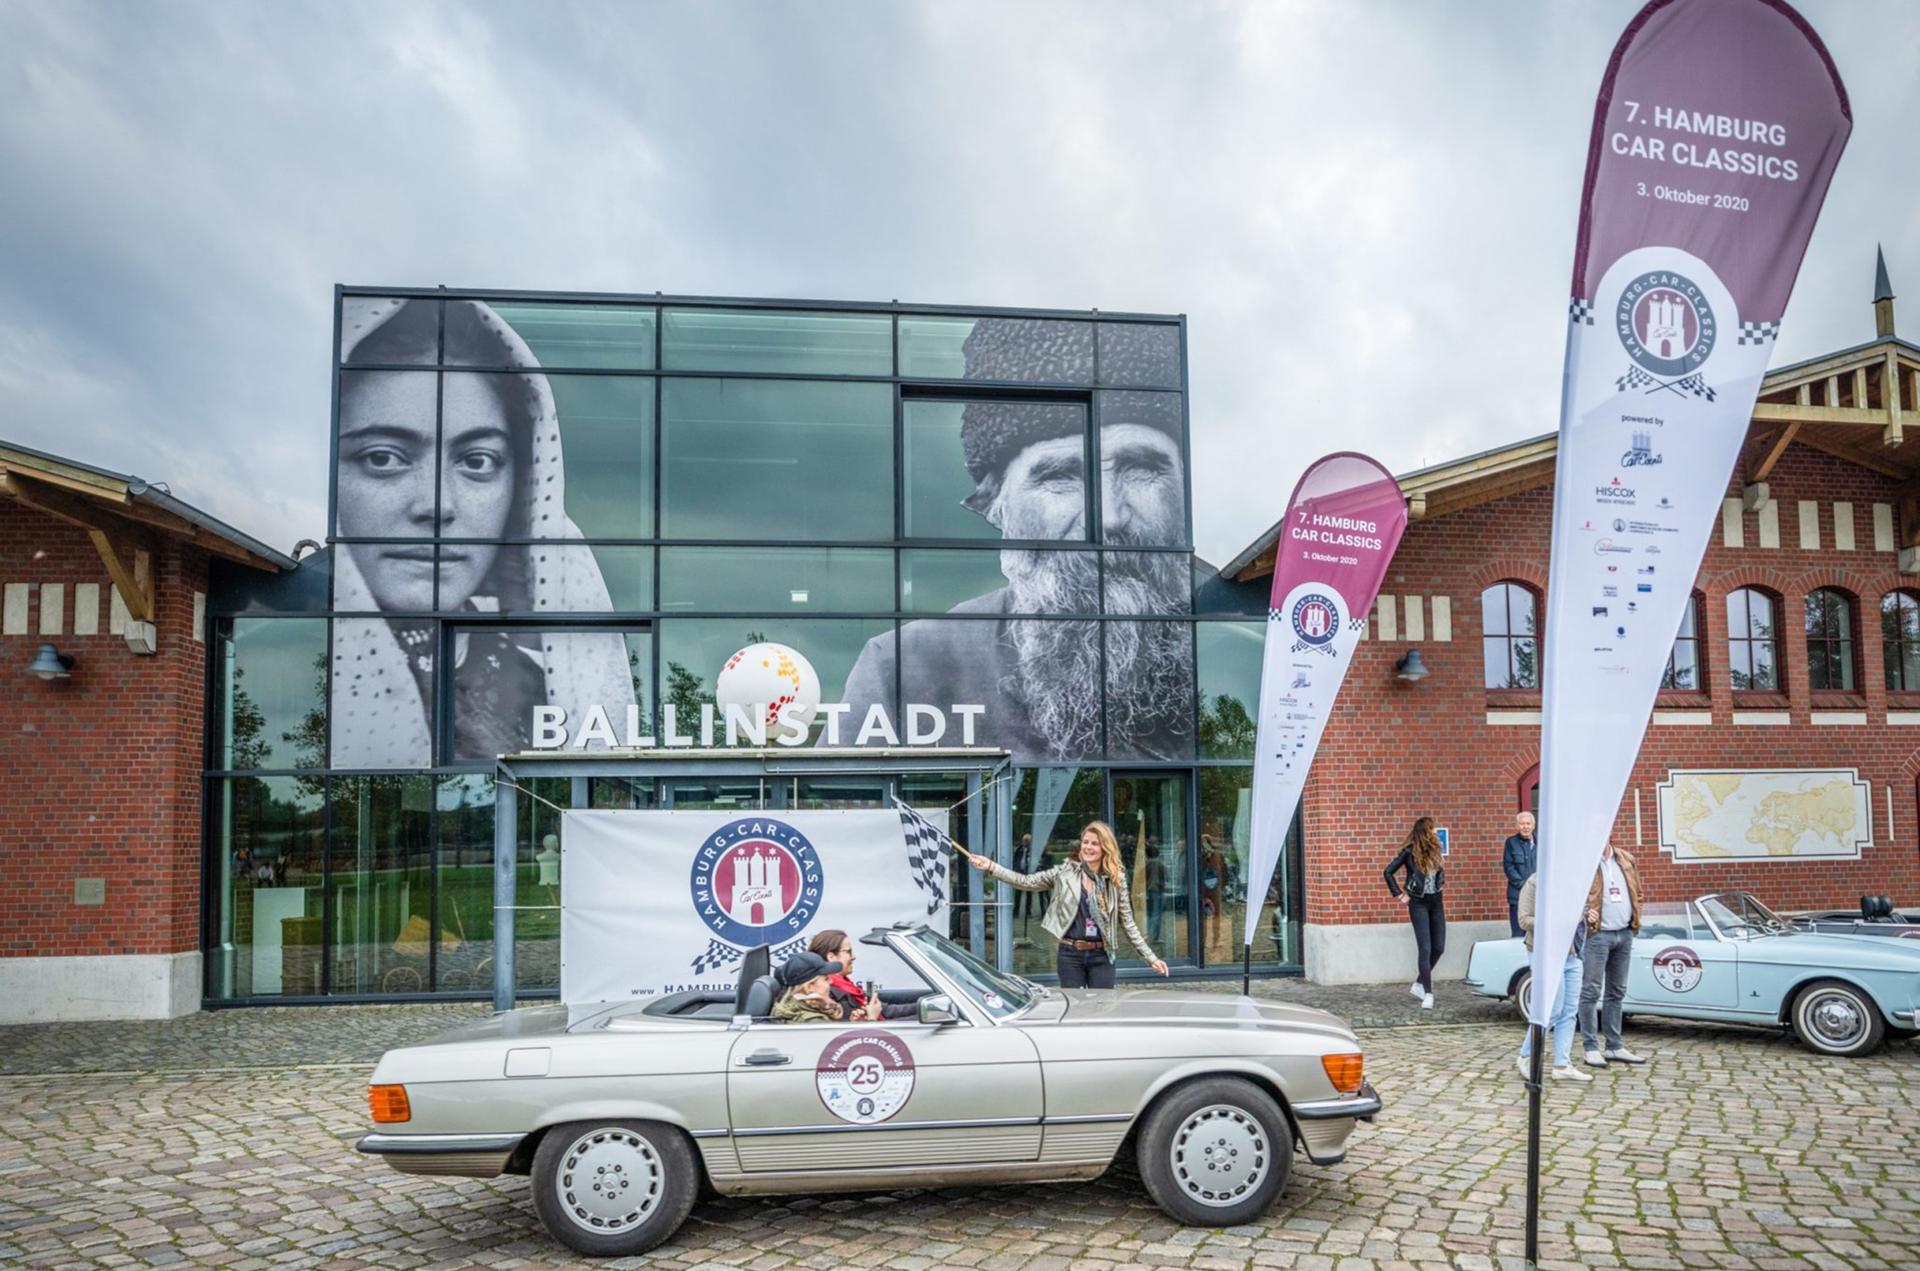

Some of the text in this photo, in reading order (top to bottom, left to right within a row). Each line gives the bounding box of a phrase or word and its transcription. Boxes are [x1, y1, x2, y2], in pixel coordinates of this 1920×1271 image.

[1624, 101, 1786, 146] 7. HAMBURG
[1611, 132, 1799, 181] CAR CLASSICS
[1637, 182, 1749, 212] 3. Oktober 2020
[1621, 415, 1664, 427] powered by
[1595, 486, 1636, 498] HISCOX
[1299, 512, 1377, 534] 7. HAMBURG
[1292, 527, 1382, 551] CAR CLASSICS
[1303, 552, 1358, 566] 3. Oktober 2020
[532, 703, 986, 748] BALLINSTADT
[1671, 963, 1684, 973] 13
[851, 1064, 880, 1085] 25
